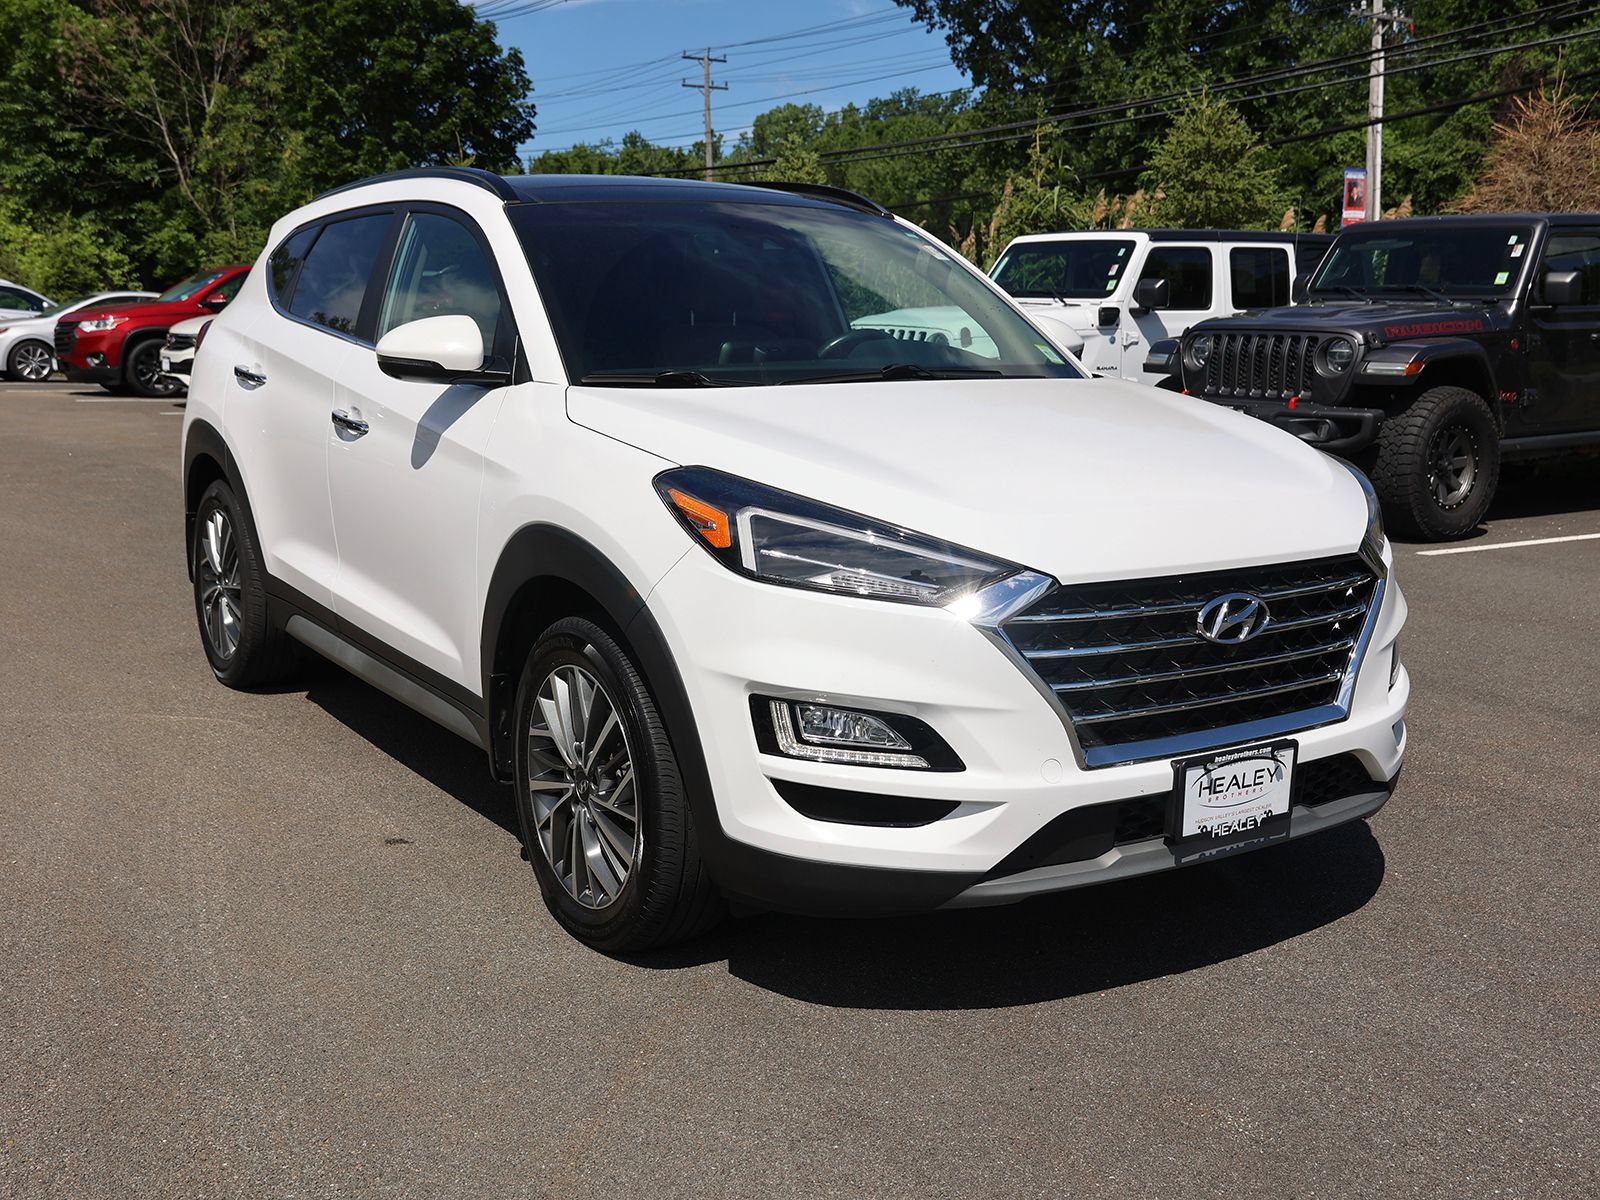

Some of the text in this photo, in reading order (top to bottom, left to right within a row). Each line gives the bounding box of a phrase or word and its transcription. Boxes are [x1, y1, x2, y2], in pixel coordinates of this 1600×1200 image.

[1384, 319, 1483, 338] RUBICON
[1214, 747, 1272, 763] healeybrothers.com
[1198, 765, 1280, 798] HEALEY
[1208, 786, 1264, 803] BROTHERS
[1211, 815, 1263, 838] HEALEY
